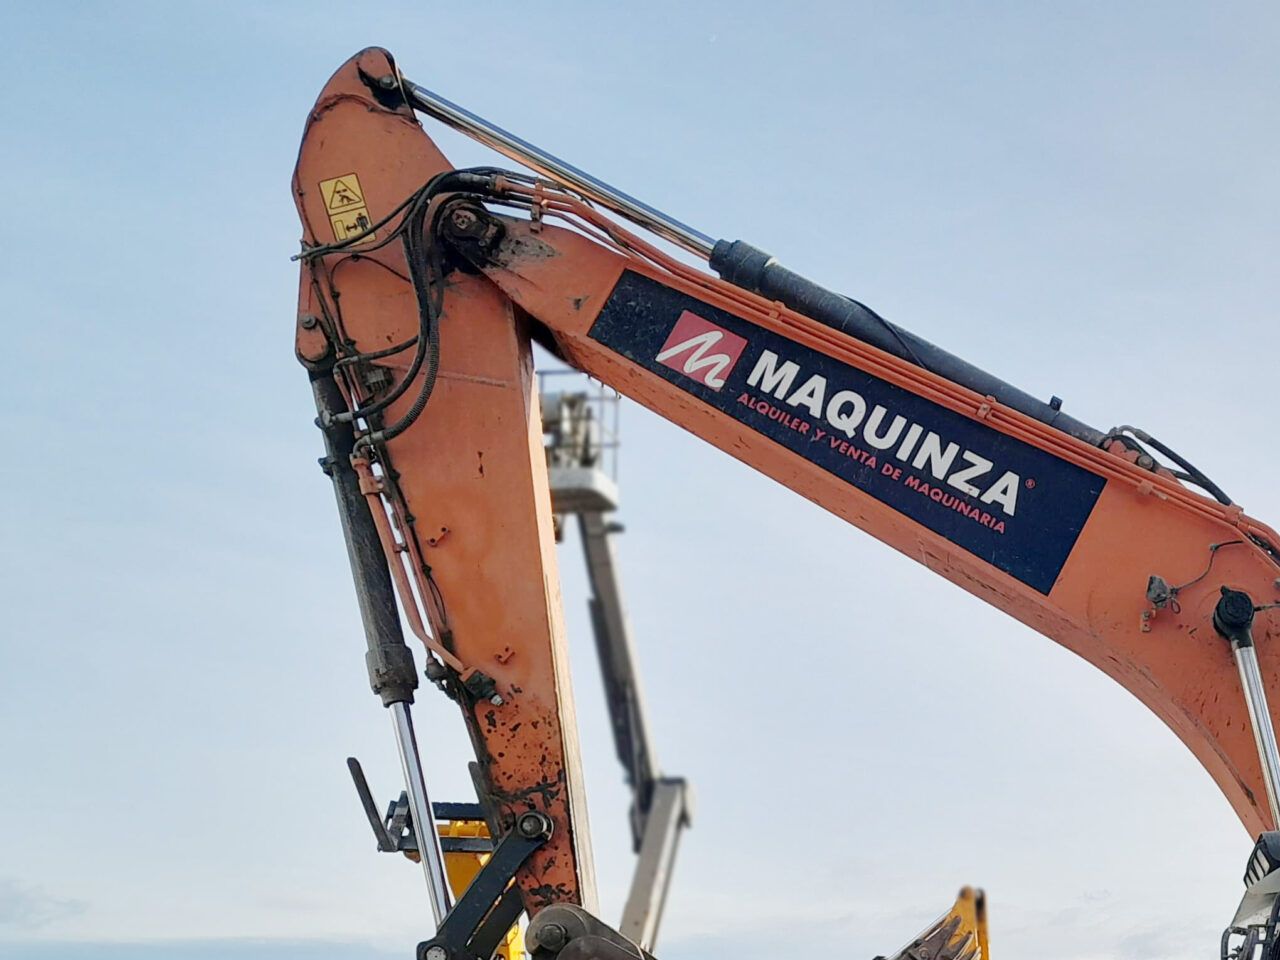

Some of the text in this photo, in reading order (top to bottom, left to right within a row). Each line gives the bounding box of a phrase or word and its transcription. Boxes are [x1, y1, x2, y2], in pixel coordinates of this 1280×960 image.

[737, 392, 1006, 534] ALQUILER Y VENTA DE MAQUINARIA
[746, 349, 1020, 517] MAQUINZA
